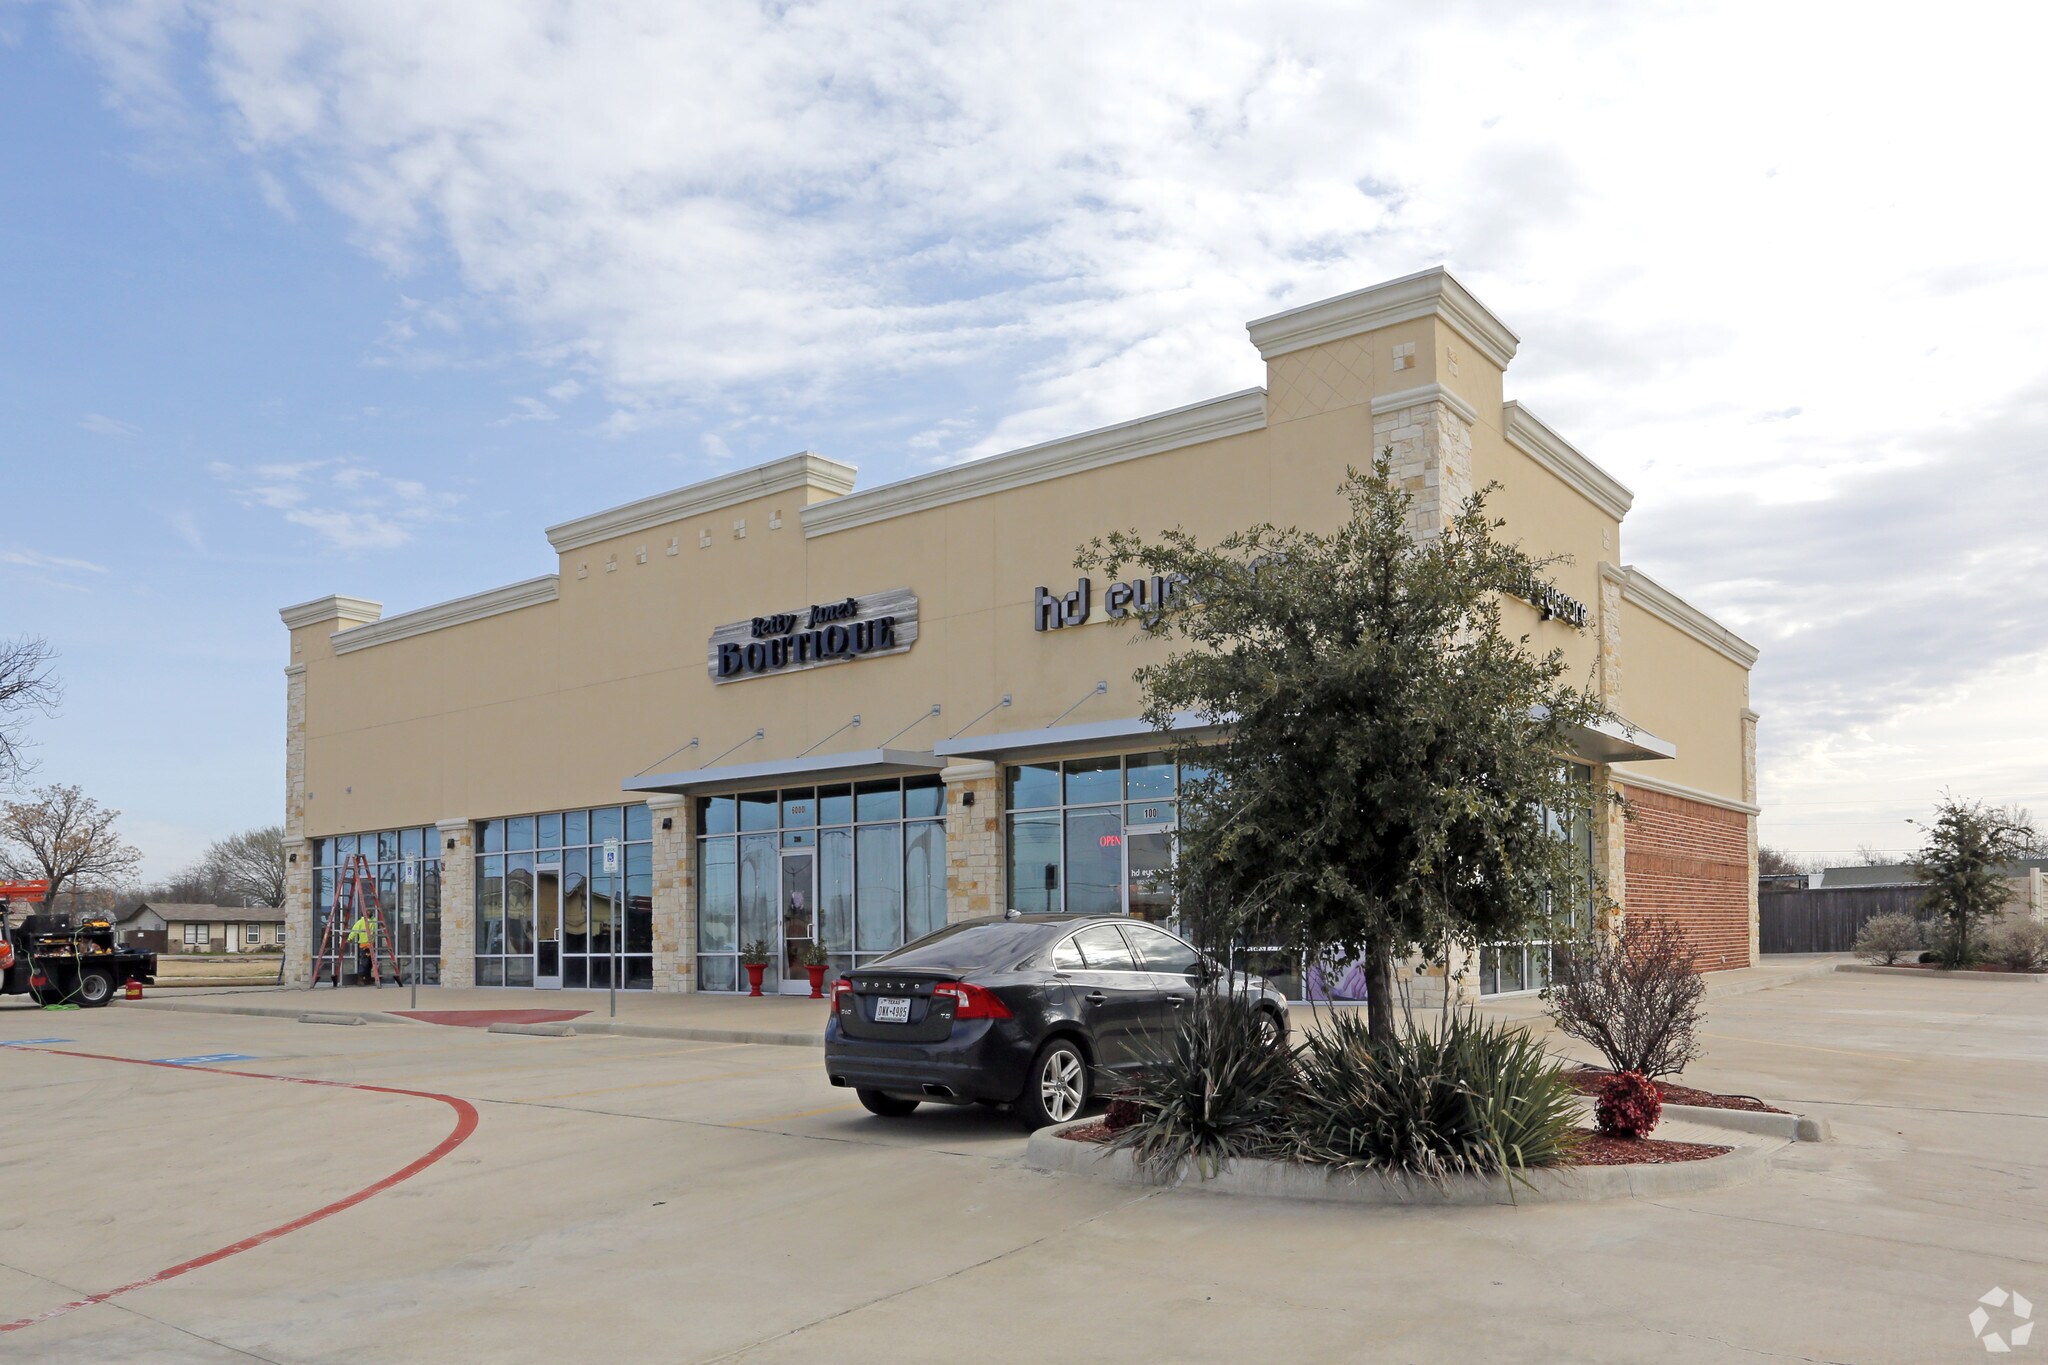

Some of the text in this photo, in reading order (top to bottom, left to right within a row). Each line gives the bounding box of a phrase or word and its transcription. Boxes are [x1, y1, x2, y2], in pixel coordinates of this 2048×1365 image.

[1035, 577, 1090, 632] hd
[751, 614, 797, 638] Betty
[717, 616, 895, 677] BOUTIQUE
[1145, 808, 1157, 818] 100
[1099, 836, 1122, 847] OPEN
